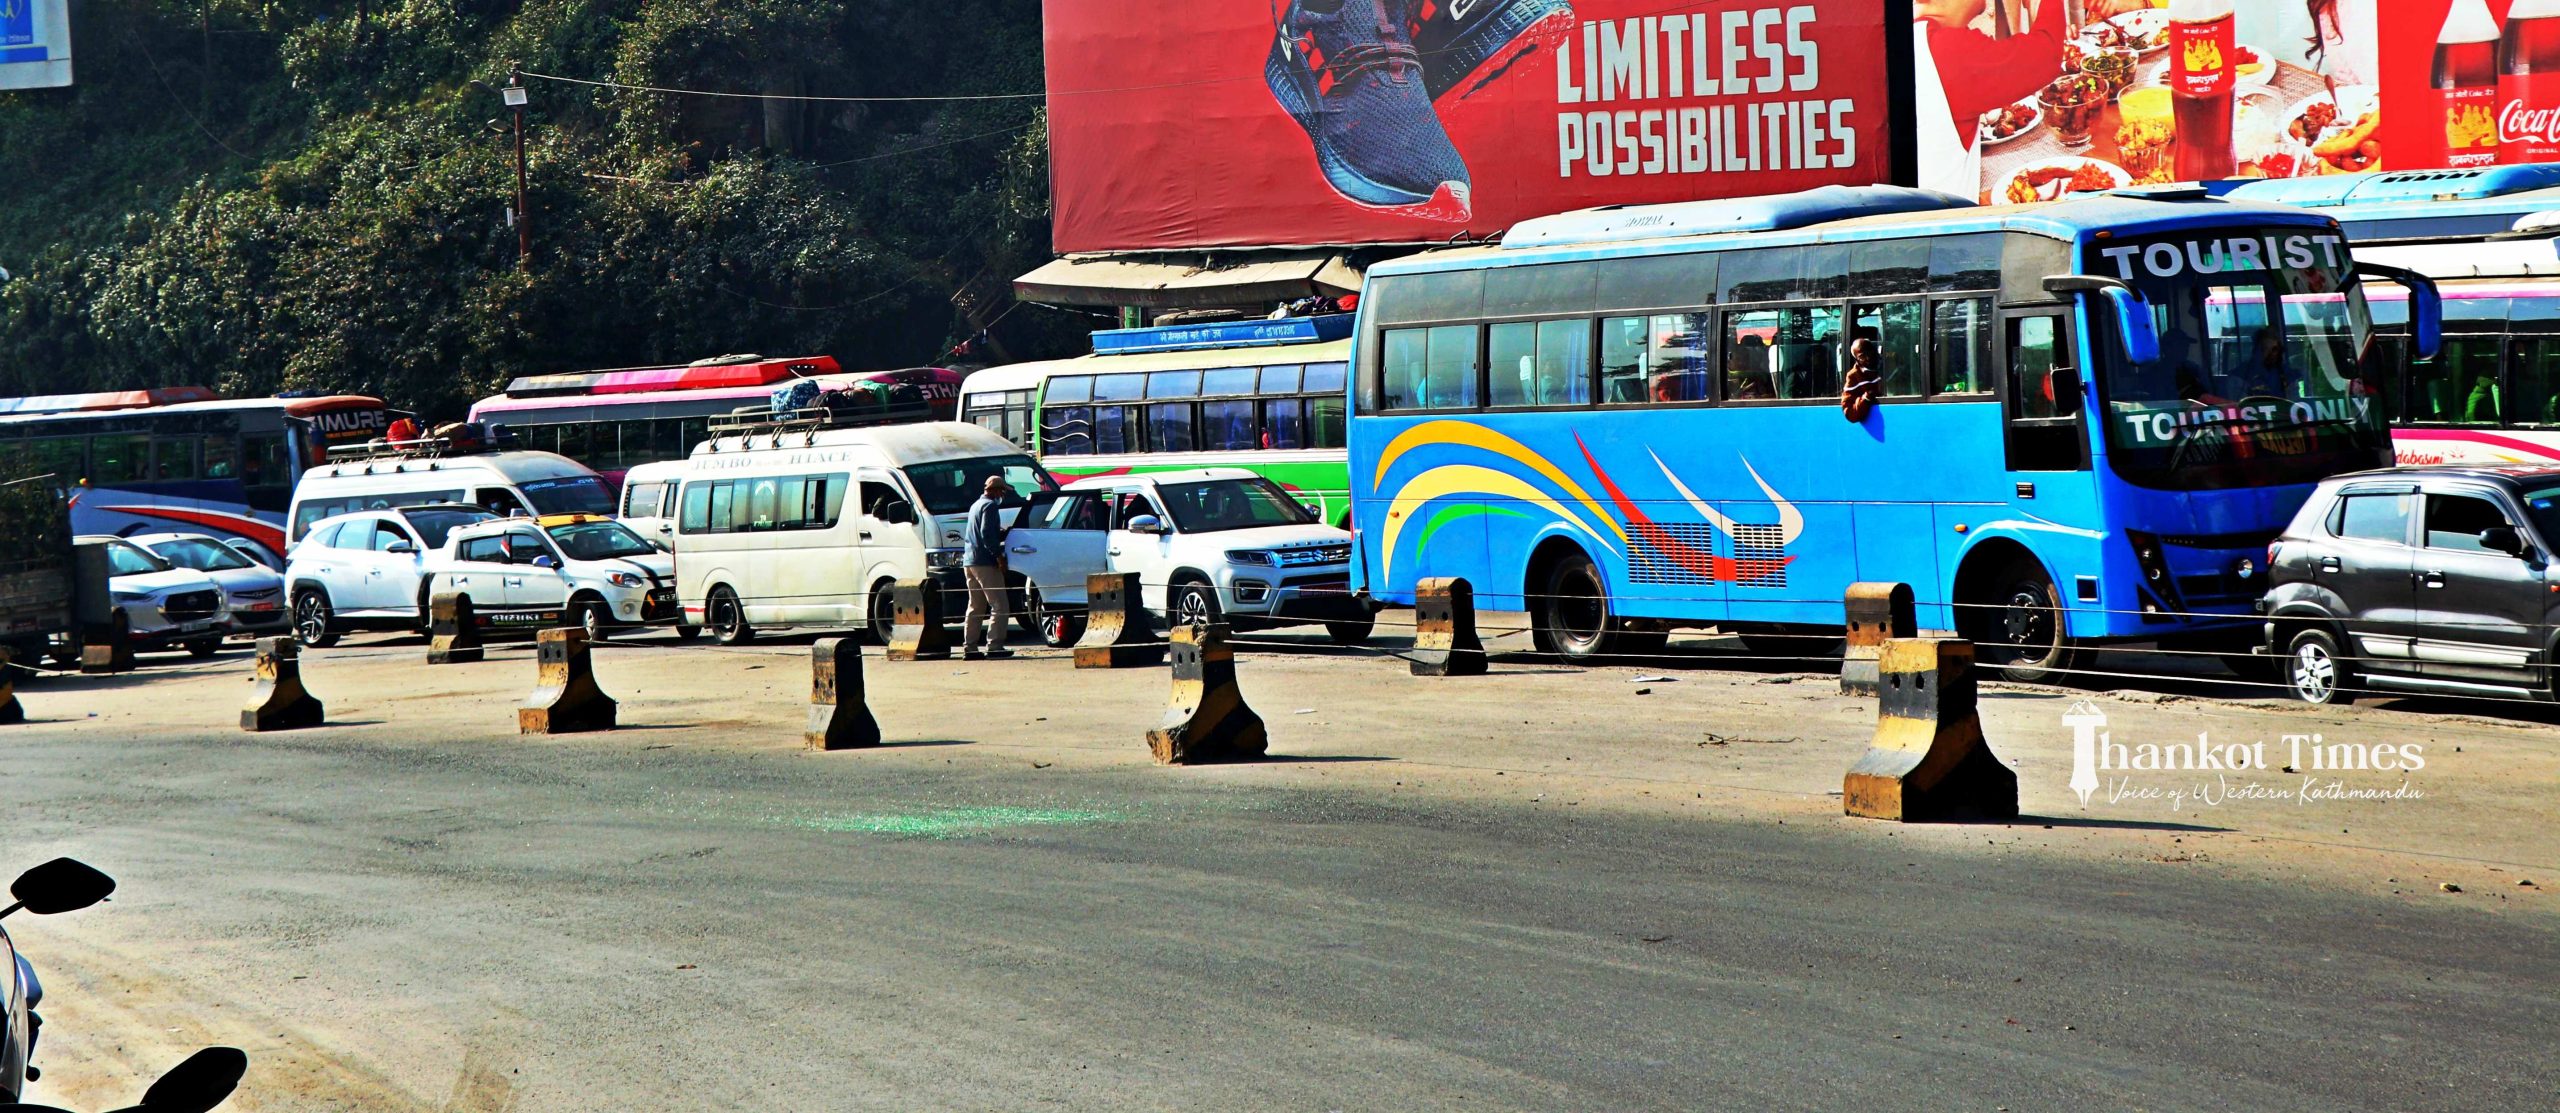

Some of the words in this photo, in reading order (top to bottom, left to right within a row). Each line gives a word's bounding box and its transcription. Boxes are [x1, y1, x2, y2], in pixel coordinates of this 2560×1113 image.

[1557, 5, 1817, 103] LIMITLESS
[1558, 98, 1856, 177] POSSIBILITIES
[2102, 235, 2342, 280] TOURIST
[2126, 404, 2278, 442] TOURIST
[2290, 396, 2371, 426] ONLY
[788, 450, 852, 465] HIACE
